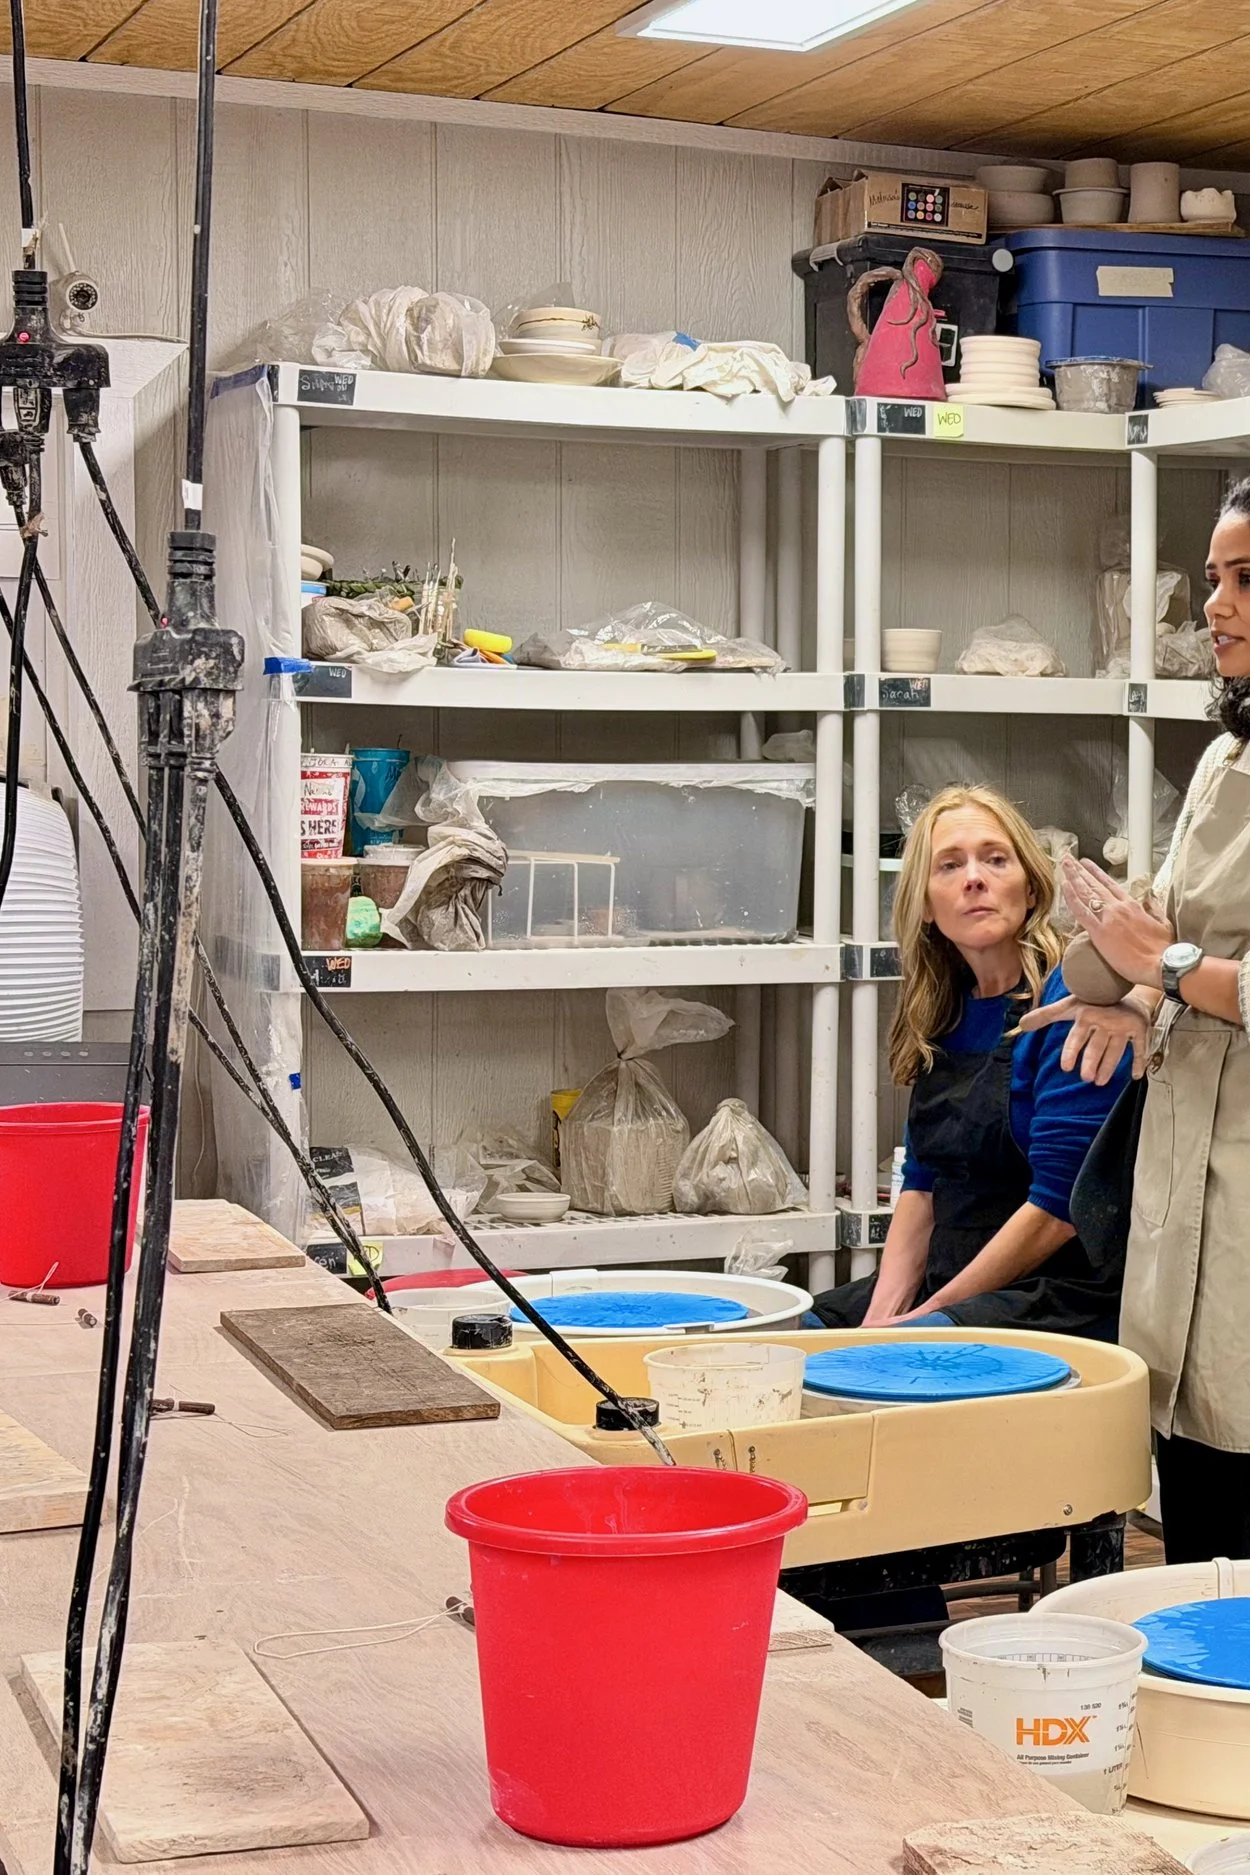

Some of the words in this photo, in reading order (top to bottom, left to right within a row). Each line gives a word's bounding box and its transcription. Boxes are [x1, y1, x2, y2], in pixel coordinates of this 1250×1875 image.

[334, 373, 355, 385] WED
[903, 406, 923, 418] WED
[937, 411, 962, 426] WED
[328, 667, 347, 679] WED
[882, 686, 919, 701] Sarah
[308, 819, 337, 836] HERE
[325, 956, 351, 971] WED
[1015, 1716, 1091, 1746] HDX
